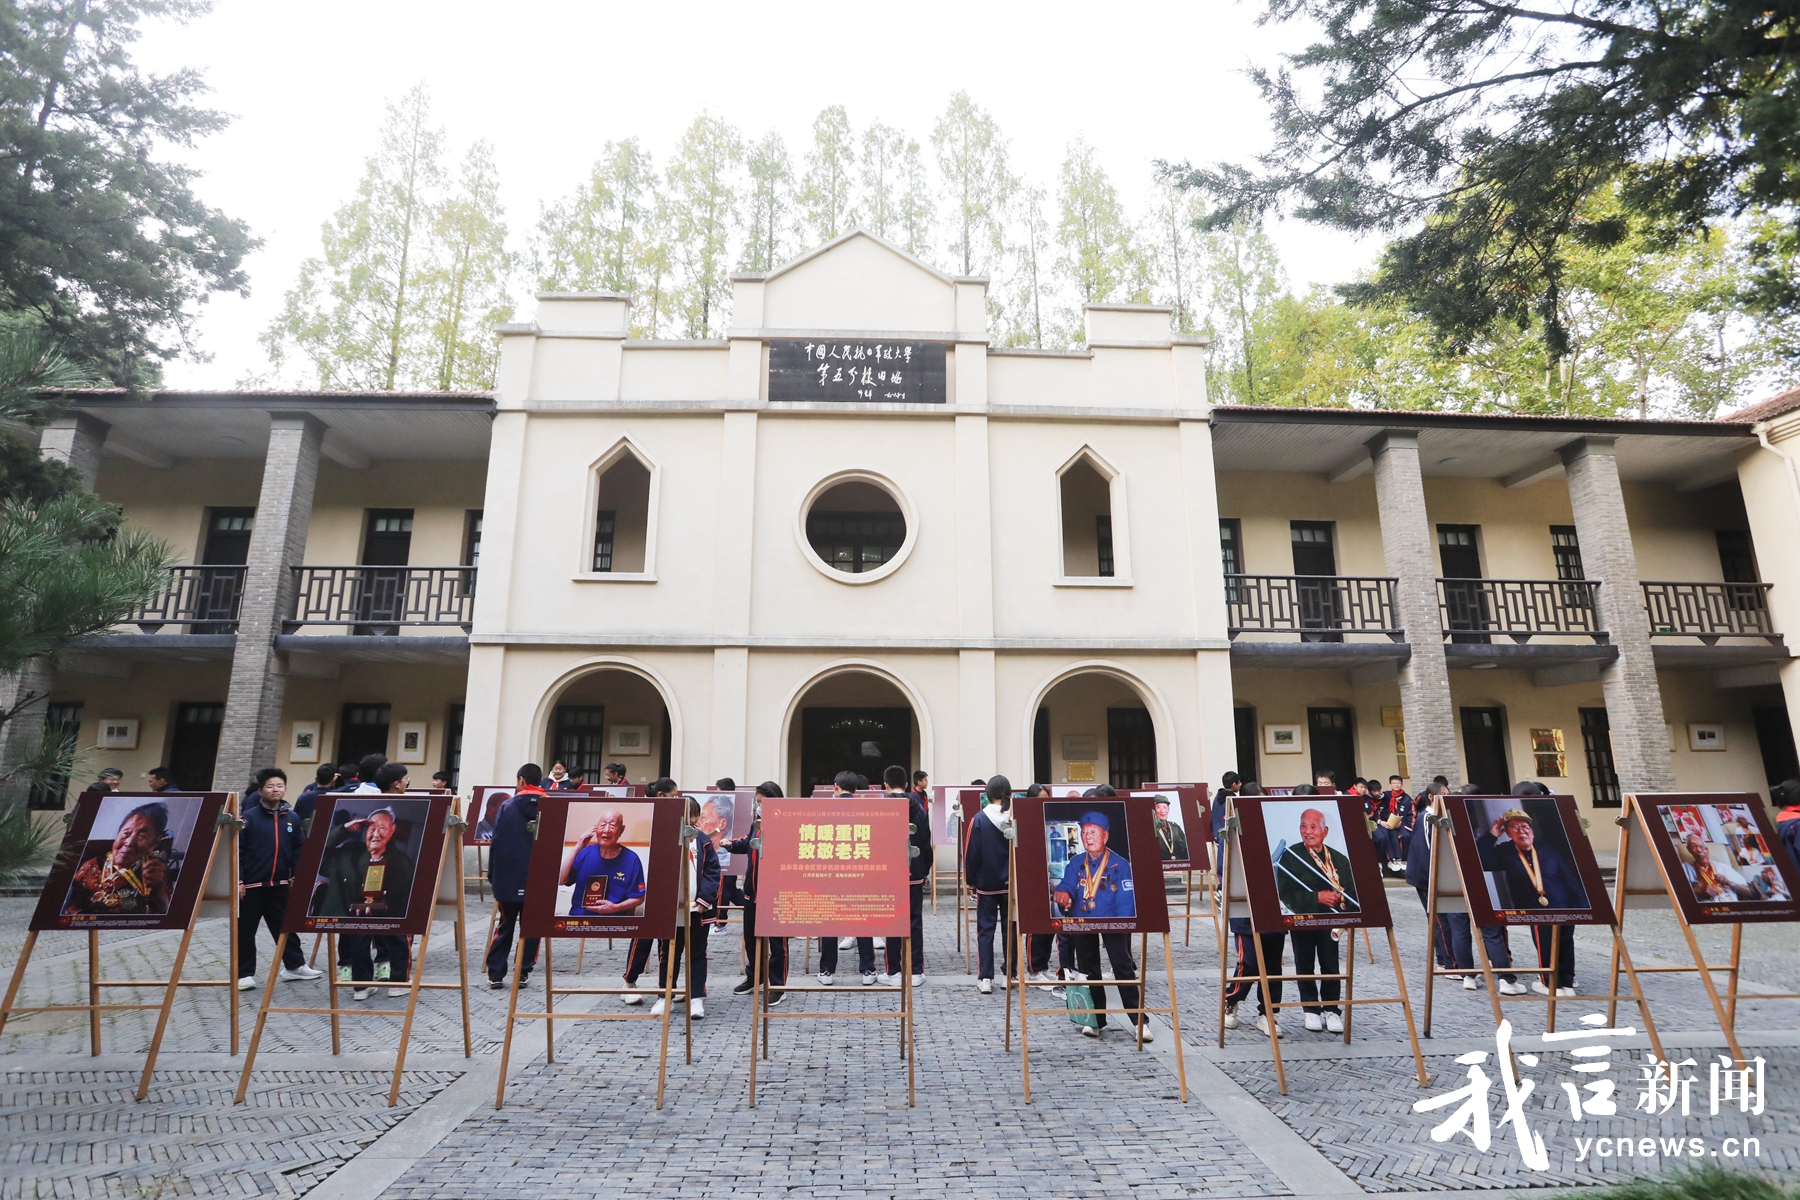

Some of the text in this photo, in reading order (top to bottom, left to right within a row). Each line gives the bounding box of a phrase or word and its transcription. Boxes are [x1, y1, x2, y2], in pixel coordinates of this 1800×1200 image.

[798, 823, 872, 842] 情暖重阳
[798, 842, 872, 860] 致敬老兵
